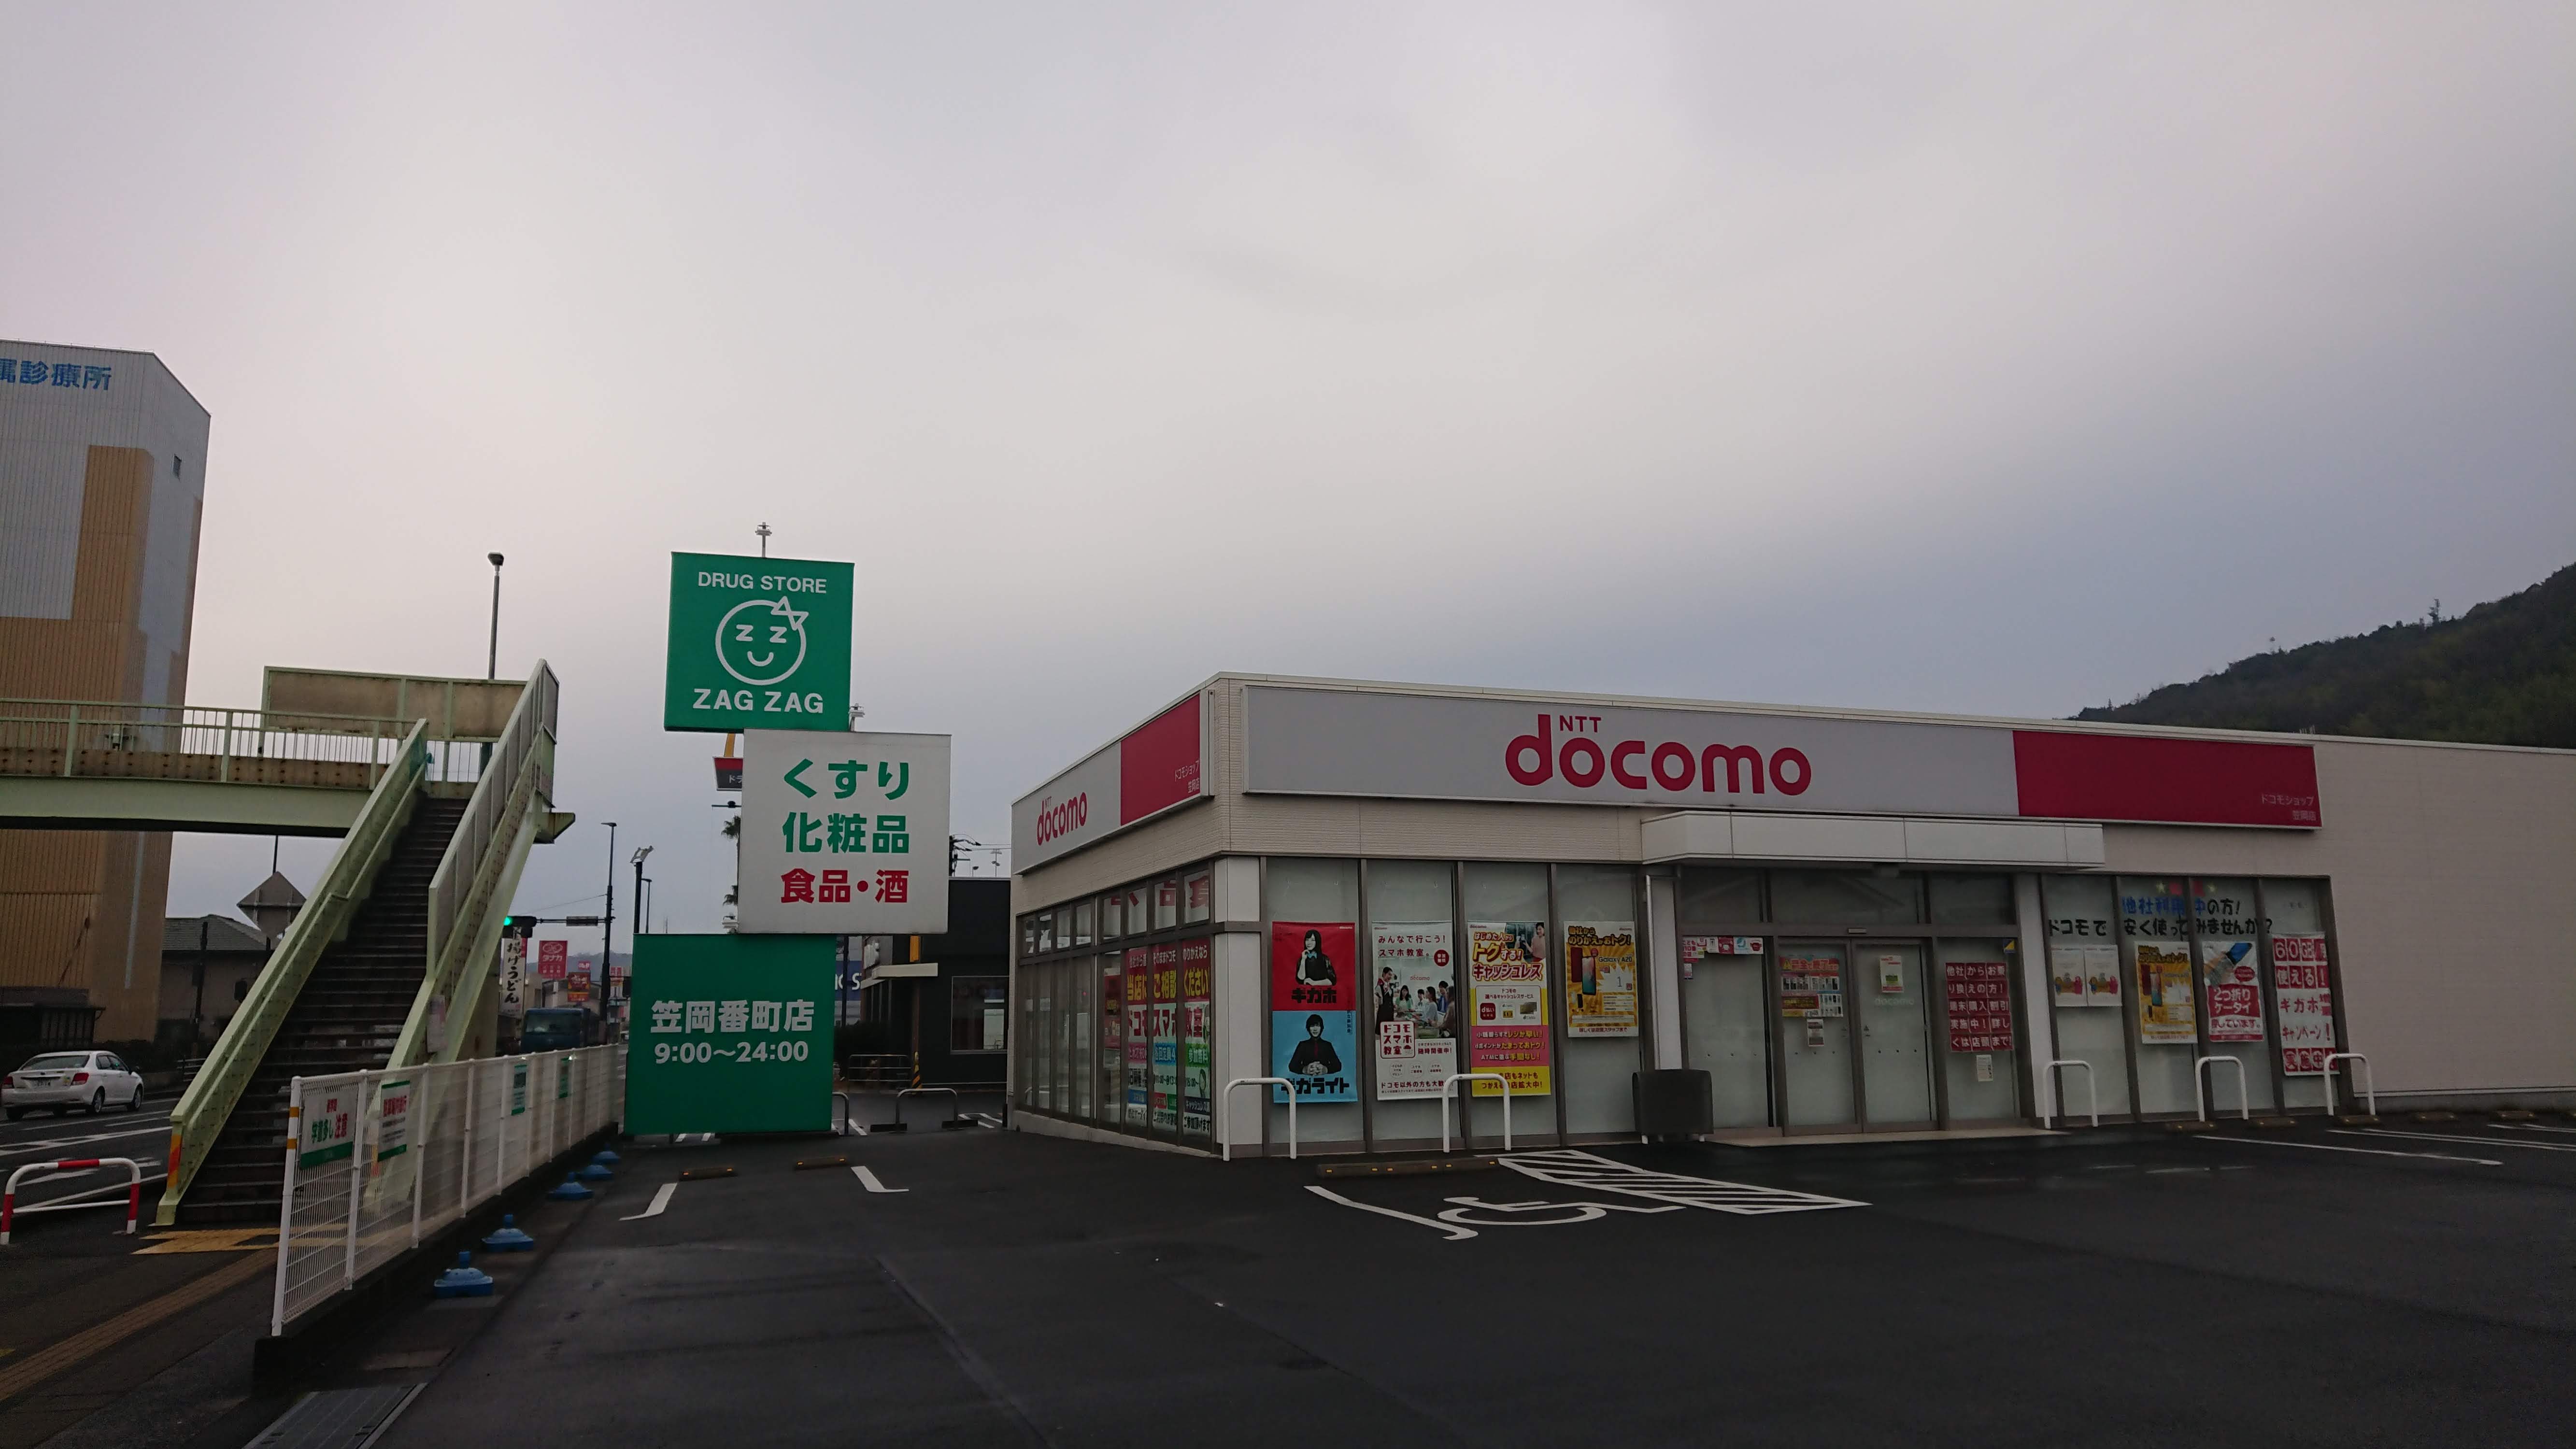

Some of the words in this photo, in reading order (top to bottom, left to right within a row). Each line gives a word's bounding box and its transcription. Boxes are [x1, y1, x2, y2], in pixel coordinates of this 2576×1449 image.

[698, 571, 754, 589] DRUG
[760, 576, 827, 594] STORE
[693, 689, 754, 711] ZAG
[764, 692, 824, 714] ZAG
[1560, 715, 1602, 733] NTT
[1505, 714, 1811, 796] docomo
[783, 758, 909, 800] くすり
[1174, 760, 1200, 781] ドコモショップ
[1188, 777, 1200, 794] 笠岡店
[2261, 794, 2314, 806] ドコモショップ
[1037, 792, 1087, 846] docomo
[782, 812, 909, 853] 化粧品
[781, 868, 909, 903] 食品・酒
[1378, 935, 1446, 944] みんなで行こう!
[1475, 933, 1514, 942] はじめた人から
[1472, 963, 1543, 981] キャッシュレス
[1291, 988, 1337, 1004] ギガホ
[650, 999, 814, 1034] 笠岡番町店
[1383, 1024, 1411, 1034] ドコモ
[1383, 1035, 1412, 1044] スマホ
[1383, 1045, 1402, 1056] 教室
